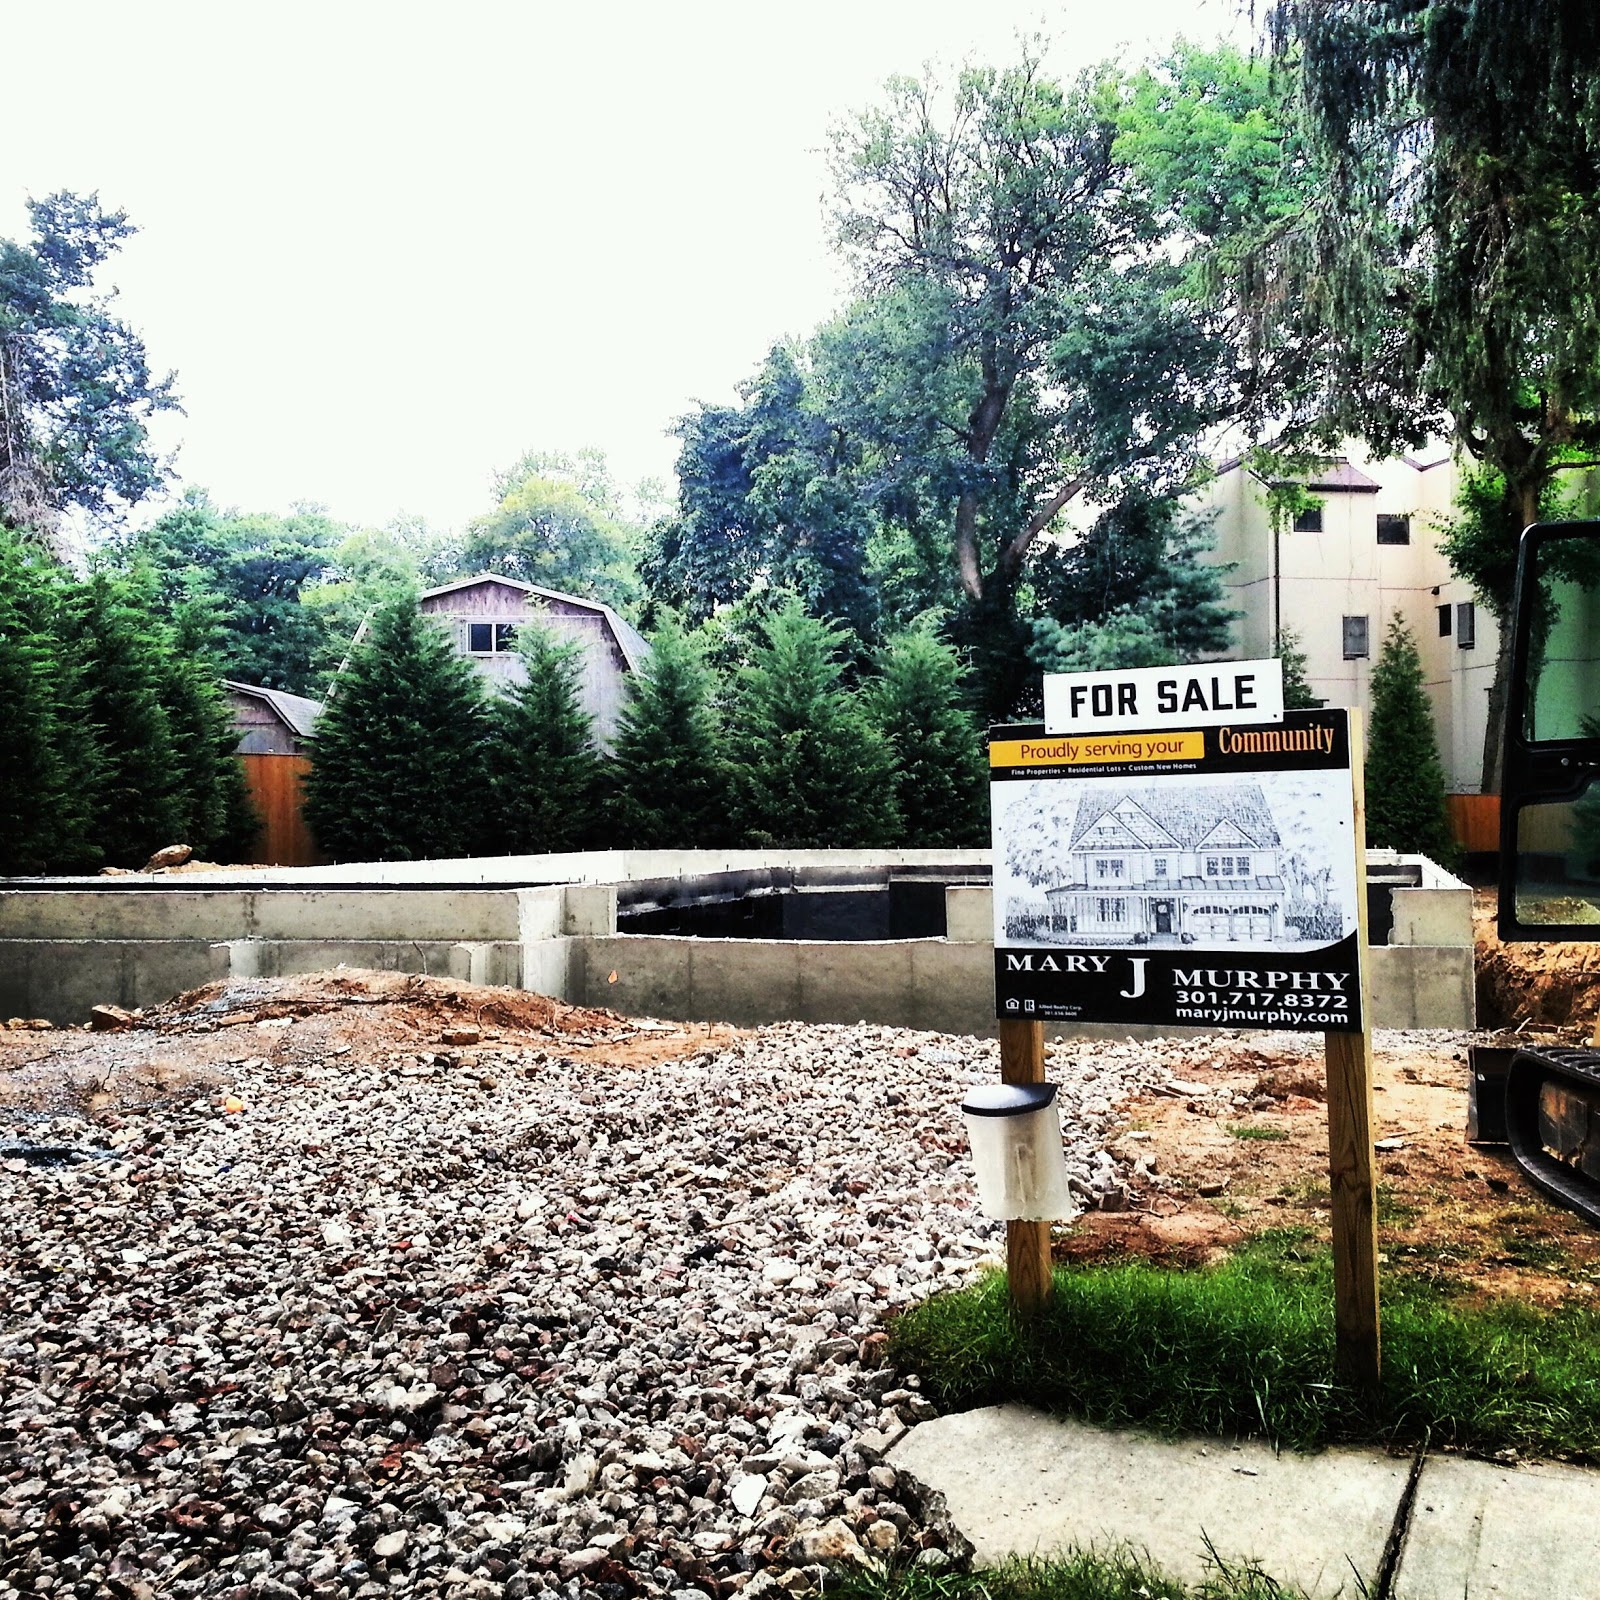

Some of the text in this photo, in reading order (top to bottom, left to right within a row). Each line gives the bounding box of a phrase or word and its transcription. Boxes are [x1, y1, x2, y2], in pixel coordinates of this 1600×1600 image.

[1069, 675, 1257, 718] FOR SALE
[1021, 722, 1335, 761] Proudly serving your Community
[1026, 768, 1061, 776] Properties
[1067, 765, 1105, 774] Residential
[1106, 765, 1121, 773] Lots
[1128, 764, 1155, 772] Custom
[1005, 954, 1351, 999] MARY J MURPHY
[1176, 990, 1348, 1009] 301.717.8372
[1176, 1006, 1348, 1025] maryjmurphy.com
